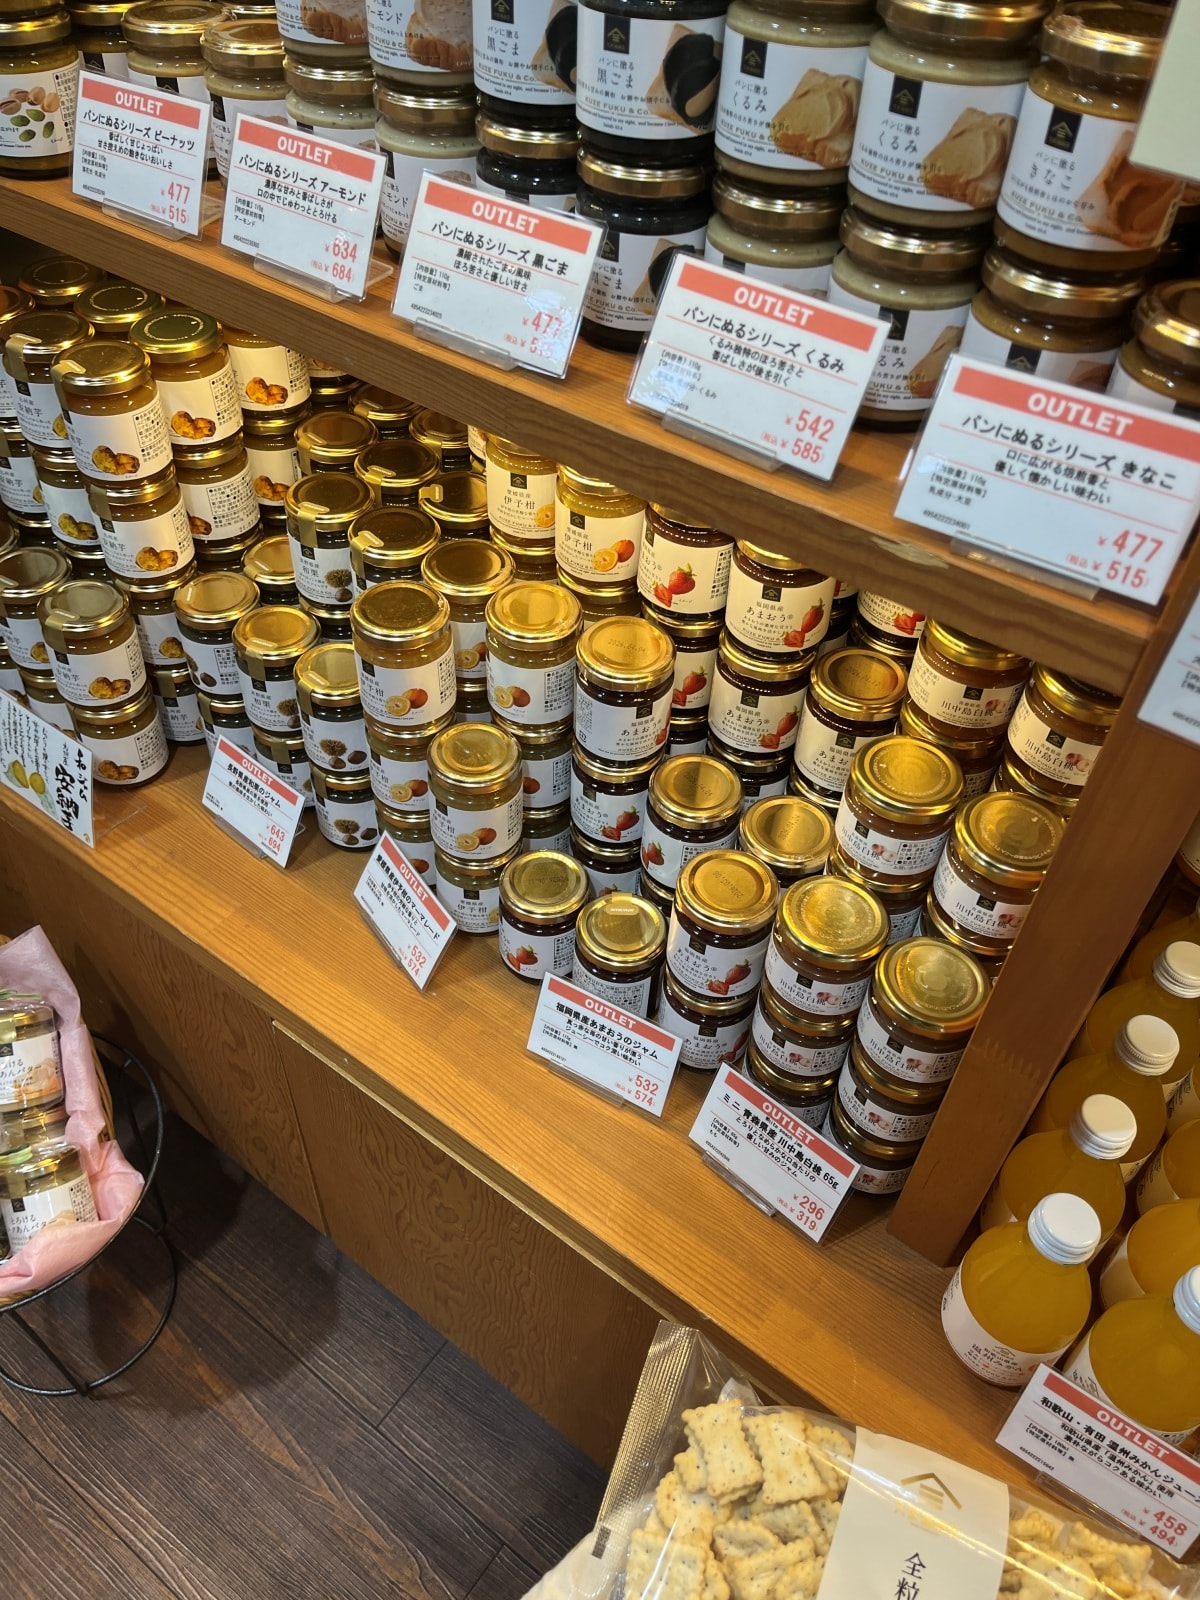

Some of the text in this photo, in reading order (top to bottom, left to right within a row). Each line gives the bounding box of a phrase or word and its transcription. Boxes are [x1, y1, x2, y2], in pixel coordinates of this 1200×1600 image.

[487, 35, 519, 56] 黒ごま
[597, 67, 634, 89] 黒ごま
[114, 90, 162, 116] OUTLET
[733, 91, 766, 114] くるみ
[83, 108, 195, 152] パンにぬるシリーズ ピーナッツ
[276, 135, 332, 165] OUTLET
[879, 131, 918, 154] くるみ
[238, 152, 366, 206] パンにぬるシリーズ アーモンド
[1029, 162, 1072, 191] きなこ
[471, 198, 539, 235] OUTLET
[431, 217, 569, 277] パンにぬるシリーズ 黒ごま
[453, 258, 528, 293] ほろ苦さと優しい甘さ
[731, 285, 814, 328] OUTLET
[682, 303, 847, 375] パンにぬるシリーズ くるみ
[1025, 390, 1134, 439] OUTLET
[961, 411, 1177, 491] パンにぬるシリーズ きなこ
[504, 495, 536, 510] 伊予柑
[241, 756, 273, 787] OUTLET
[398, 861, 428, 903] OUTLET
[555, 1001, 659, 1059] 福岡県産あまおうのジャム
[584, 997, 636, 1030] OUTLET
[760, 1100, 815, 1146] OUTLET
[735, 1115, 817, 1183] とろりとなめらかな口当たりの
[741, 1108, 778, 1140] 青森県産
[776, 1135, 823, 1176] 川中島白桃
[821, 1171, 840, 1190] 65g
[745, 1132, 799, 1177] 優しい甘みのジャム
[1095, 1407, 1169, 1462] OUTLET
